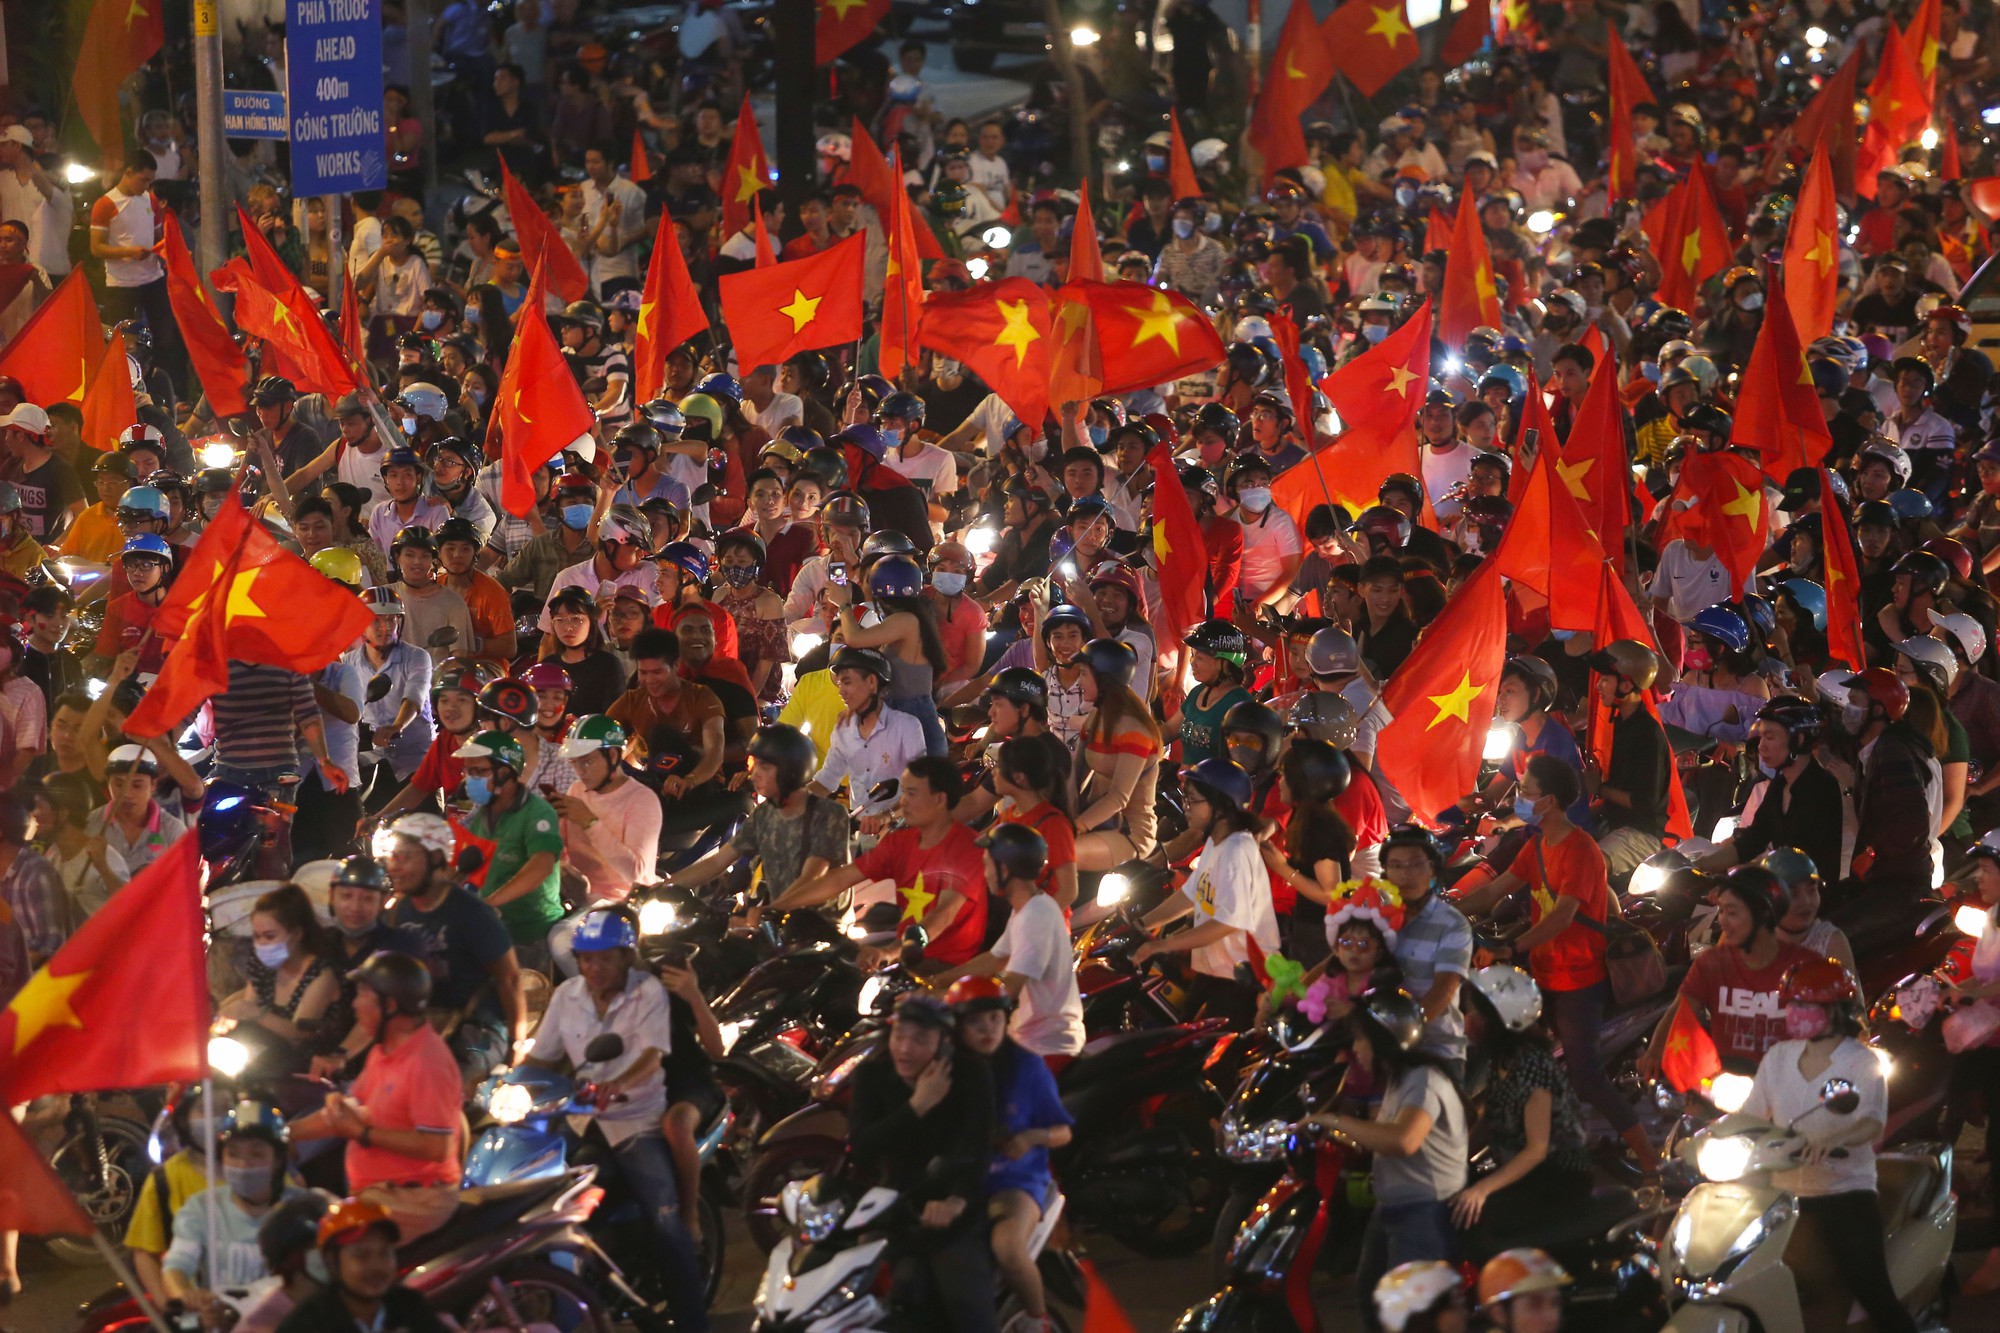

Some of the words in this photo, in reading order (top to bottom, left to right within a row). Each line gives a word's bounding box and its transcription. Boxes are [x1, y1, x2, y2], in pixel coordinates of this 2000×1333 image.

[201, 11, 209, 24] 3
[315, 36, 356, 62] AHEAD
[316, 77, 349, 101] 400m
[295, 112, 328, 142] CÔNG
[330, 106, 379, 137] TRƯỜNG
[316, 150, 361, 178] WORKS
[18, 488, 45, 506] NGS
